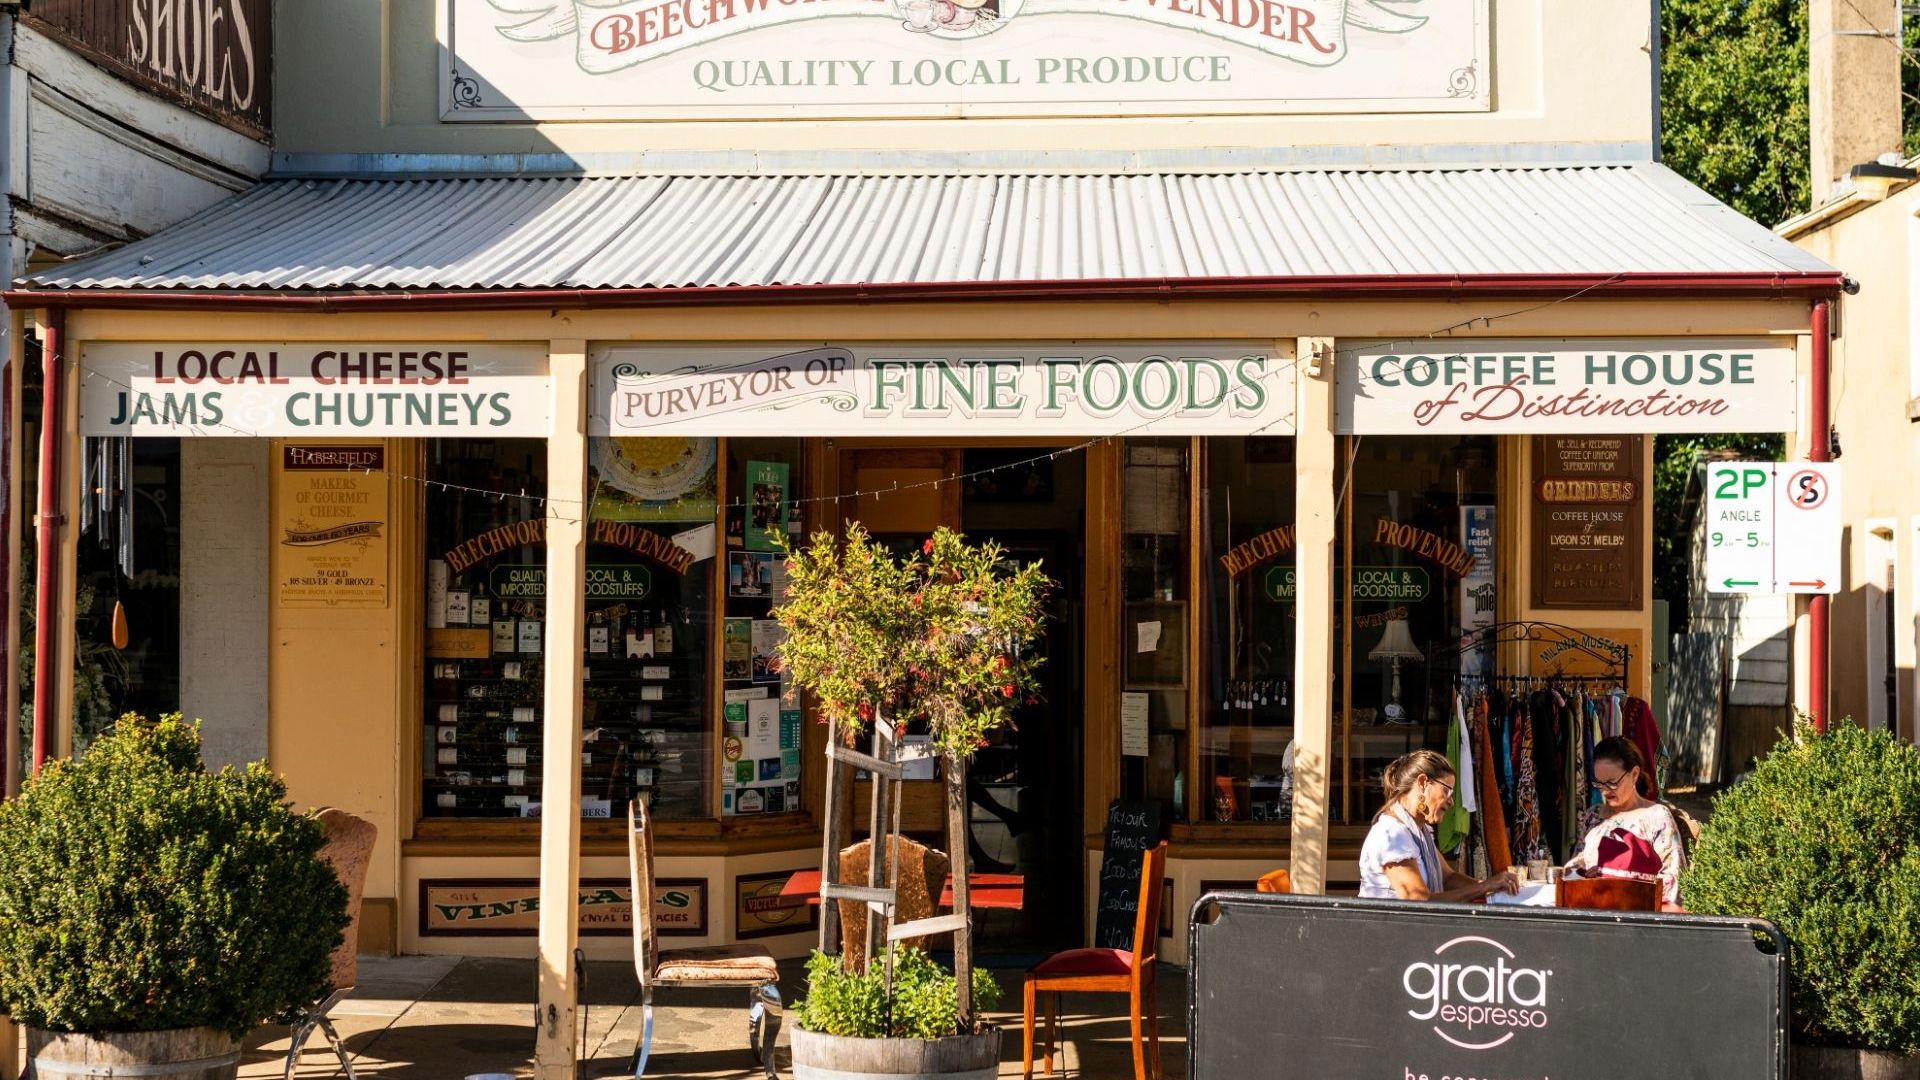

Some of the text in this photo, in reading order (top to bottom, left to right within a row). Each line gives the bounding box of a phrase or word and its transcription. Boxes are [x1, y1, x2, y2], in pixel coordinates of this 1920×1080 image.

[590, 0, 886, 54] BEECH
[128, 0, 255, 111] SHOES
[693, 55, 1232, 92] QUALITY LOCAL PRODUCE
[154, 350, 470, 385] LOCAL CHEESE
[1371, 353, 1755, 387] COFFEE HOUSE
[624, 356, 847, 418] PURVEYOR OF
[866, 355, 1268, 414] FINE FOODS
[109, 390, 512, 428] JAMS & CHUTNEYS
[1413, 374, 1731, 426] of Distinction
[1559, 450, 1582, 460] COFFEE
[310, 478, 357, 490] MAKERS
[1543, 479, 1634, 502] GRINDERS
[1715, 469, 1767, 499] 2P
[295, 491, 370, 505] OF GOURMET
[1551, 511, 1624, 522] COFFEE HOUSE
[1720, 510, 1761, 522] ANGLE
[1471, 527, 1490, 537] Fast
[1582, 521, 1595, 534] of
[445, 517, 697, 576] BEECHWORT PROVENDER
[1375, 519, 1477, 578] PROVENDER
[1468, 537, 1493, 546] relief
[1550, 535, 1578, 546] LYGON
[301, 578, 328, 586] SILVER
[344, 578, 376, 586] BRONZE
[326, 570, 348, 578] GOLD
[585, 569, 617, 582] OCAL
[622, 569, 632, 582] &
[1358, 571, 1412, 584] LOCAL &
[500, 582, 644, 596] IMPORTED OODSTUFFS
[1353, 584, 1422, 598] FOODSTUFFS
[1403, 957, 1547, 1020] grata
[1440, 1004, 1548, 1031] espresso
